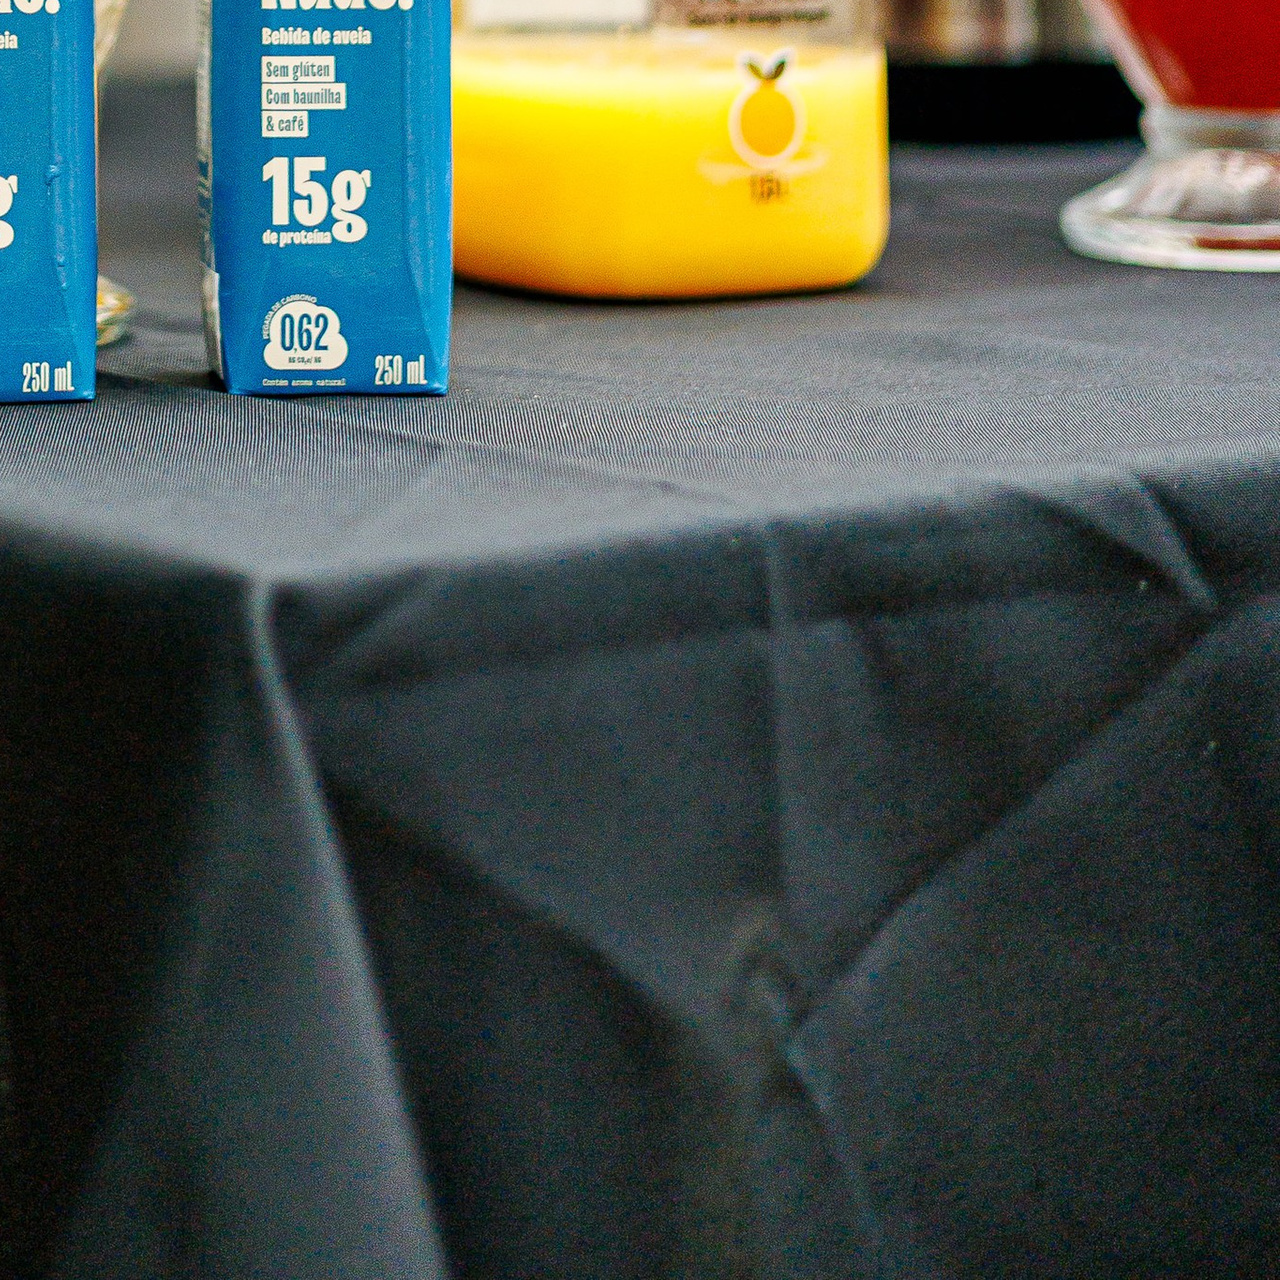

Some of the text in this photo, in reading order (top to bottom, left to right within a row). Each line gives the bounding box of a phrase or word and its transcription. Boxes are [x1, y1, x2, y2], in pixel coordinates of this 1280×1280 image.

[261, 26, 372, 45] Bebida de aveia
[266, 61, 330, 81] Sem glúten
[266, 88, 341, 105] Com baunilha
[266, 115, 304, 132] & café
[262, 156, 371, 243] 15g
[262, 229, 279, 245] de
[280, 313, 329, 353] 0,62
[22, 361, 75, 392] 250 mL
[375, 354, 428, 385] 250 mL
